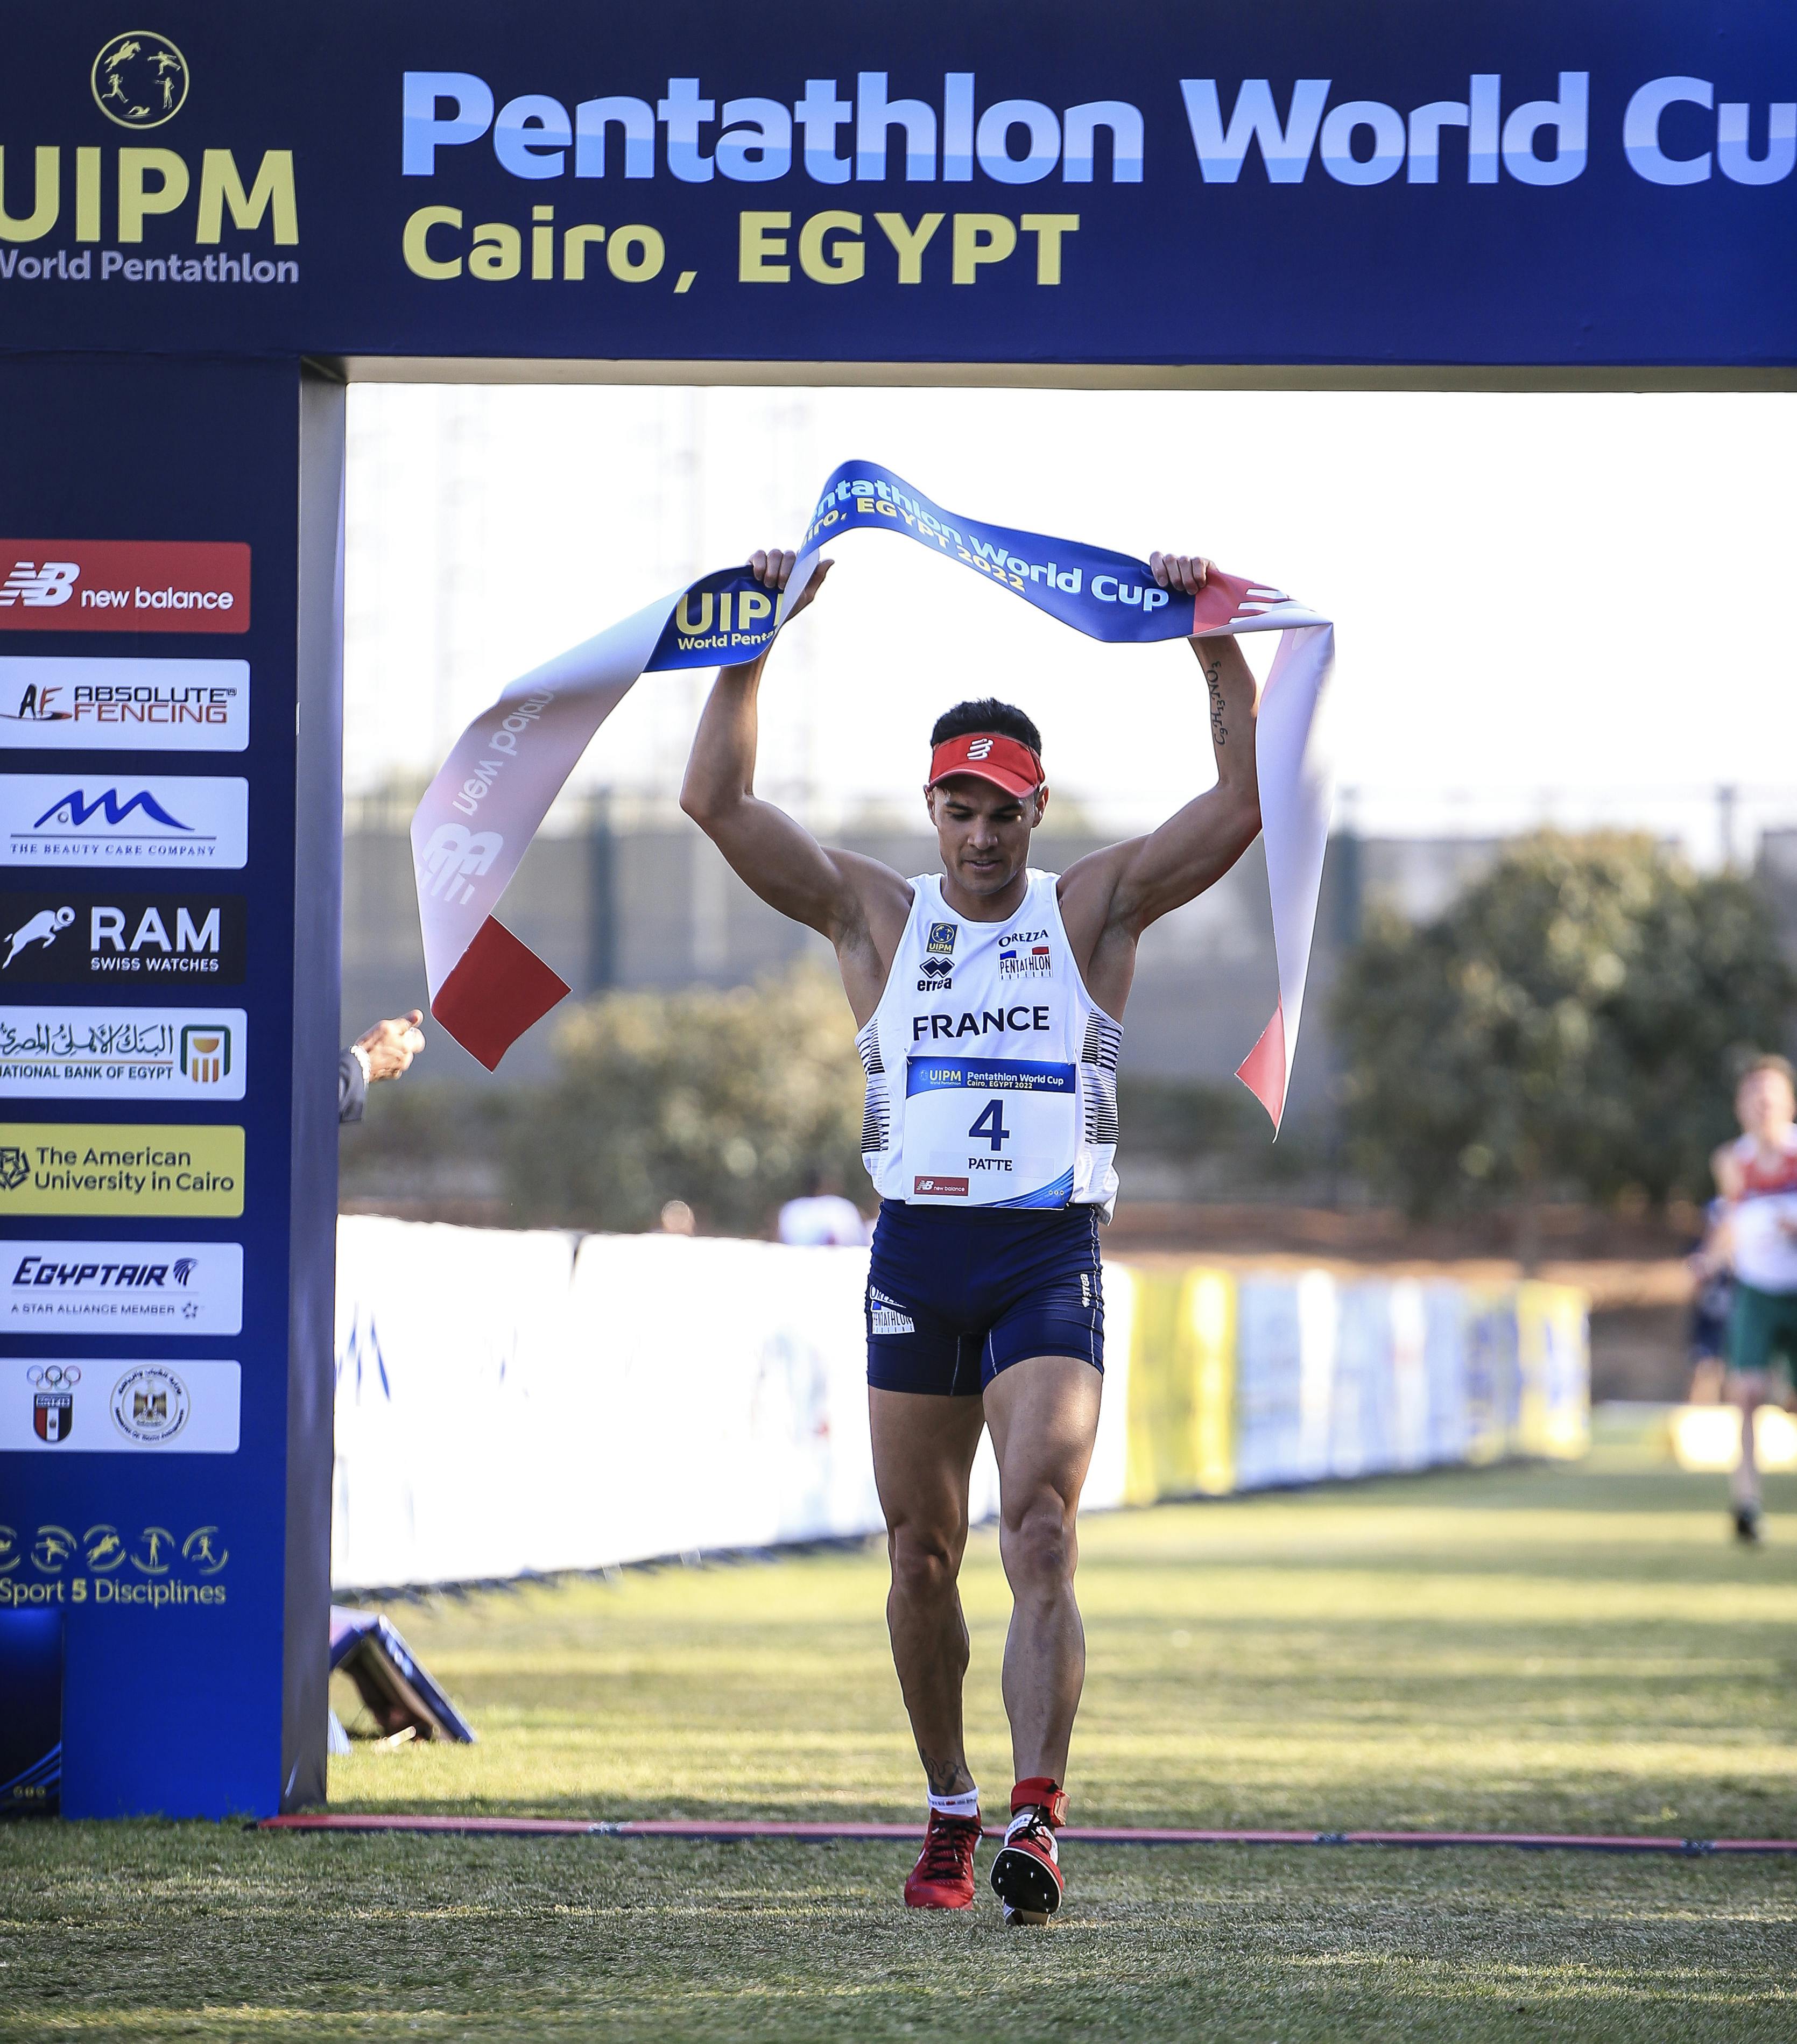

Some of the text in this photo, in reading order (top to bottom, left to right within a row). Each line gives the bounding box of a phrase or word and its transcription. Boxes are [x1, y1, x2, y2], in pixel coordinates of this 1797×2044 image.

[401, 71, 1145, 185] Pentathlon
[1179, 71, 1590, 186] World
[0, 146, 299, 245] UIPM
[402, 205, 1080, 293] Cairo, EGYPT
[101, 250, 299, 283] Pentathlon
[856, 496, 950, 549] EGYPT
[955, 544, 1026, 593] 2022
[968, 534, 1082, 594] World
[1091, 574, 1169, 612] Cup
[81, 588, 130, 609] new
[134, 586, 234, 610] balance
[677, 632, 727, 650] World
[74, 702, 228, 724] FENCING
[11, 843, 216, 857] THE BEAUTY CARE COMPANY
[90, 905, 221, 953] RAM
[998, 928, 1049, 948] OREZZA
[929, 943, 952, 951] UIPM
[90, 956, 220, 972] SWISS WATCHES
[1000, 955, 1051, 975] PENTATHLON
[913, 1005, 1050, 1041] FRANCE
[65, 1065, 103, 1079] BANK
[107, 1066, 123, 1079] OF
[129, 1066, 174, 1080] EGYPT
[929, 1069, 1064, 1086] UIPM Pentathlon World Cup
[968, 1099, 1010, 1152] 4
[36, 1146, 191, 1166] The American
[968, 1158, 1012, 1171] PATTE
[34, 1171, 235, 1194] University in Cairo
[11, 1303, 175, 1314] A STAR ALLIANCE MEMBER
[0, 1577, 227, 1610] Sport 5 Disciplines
